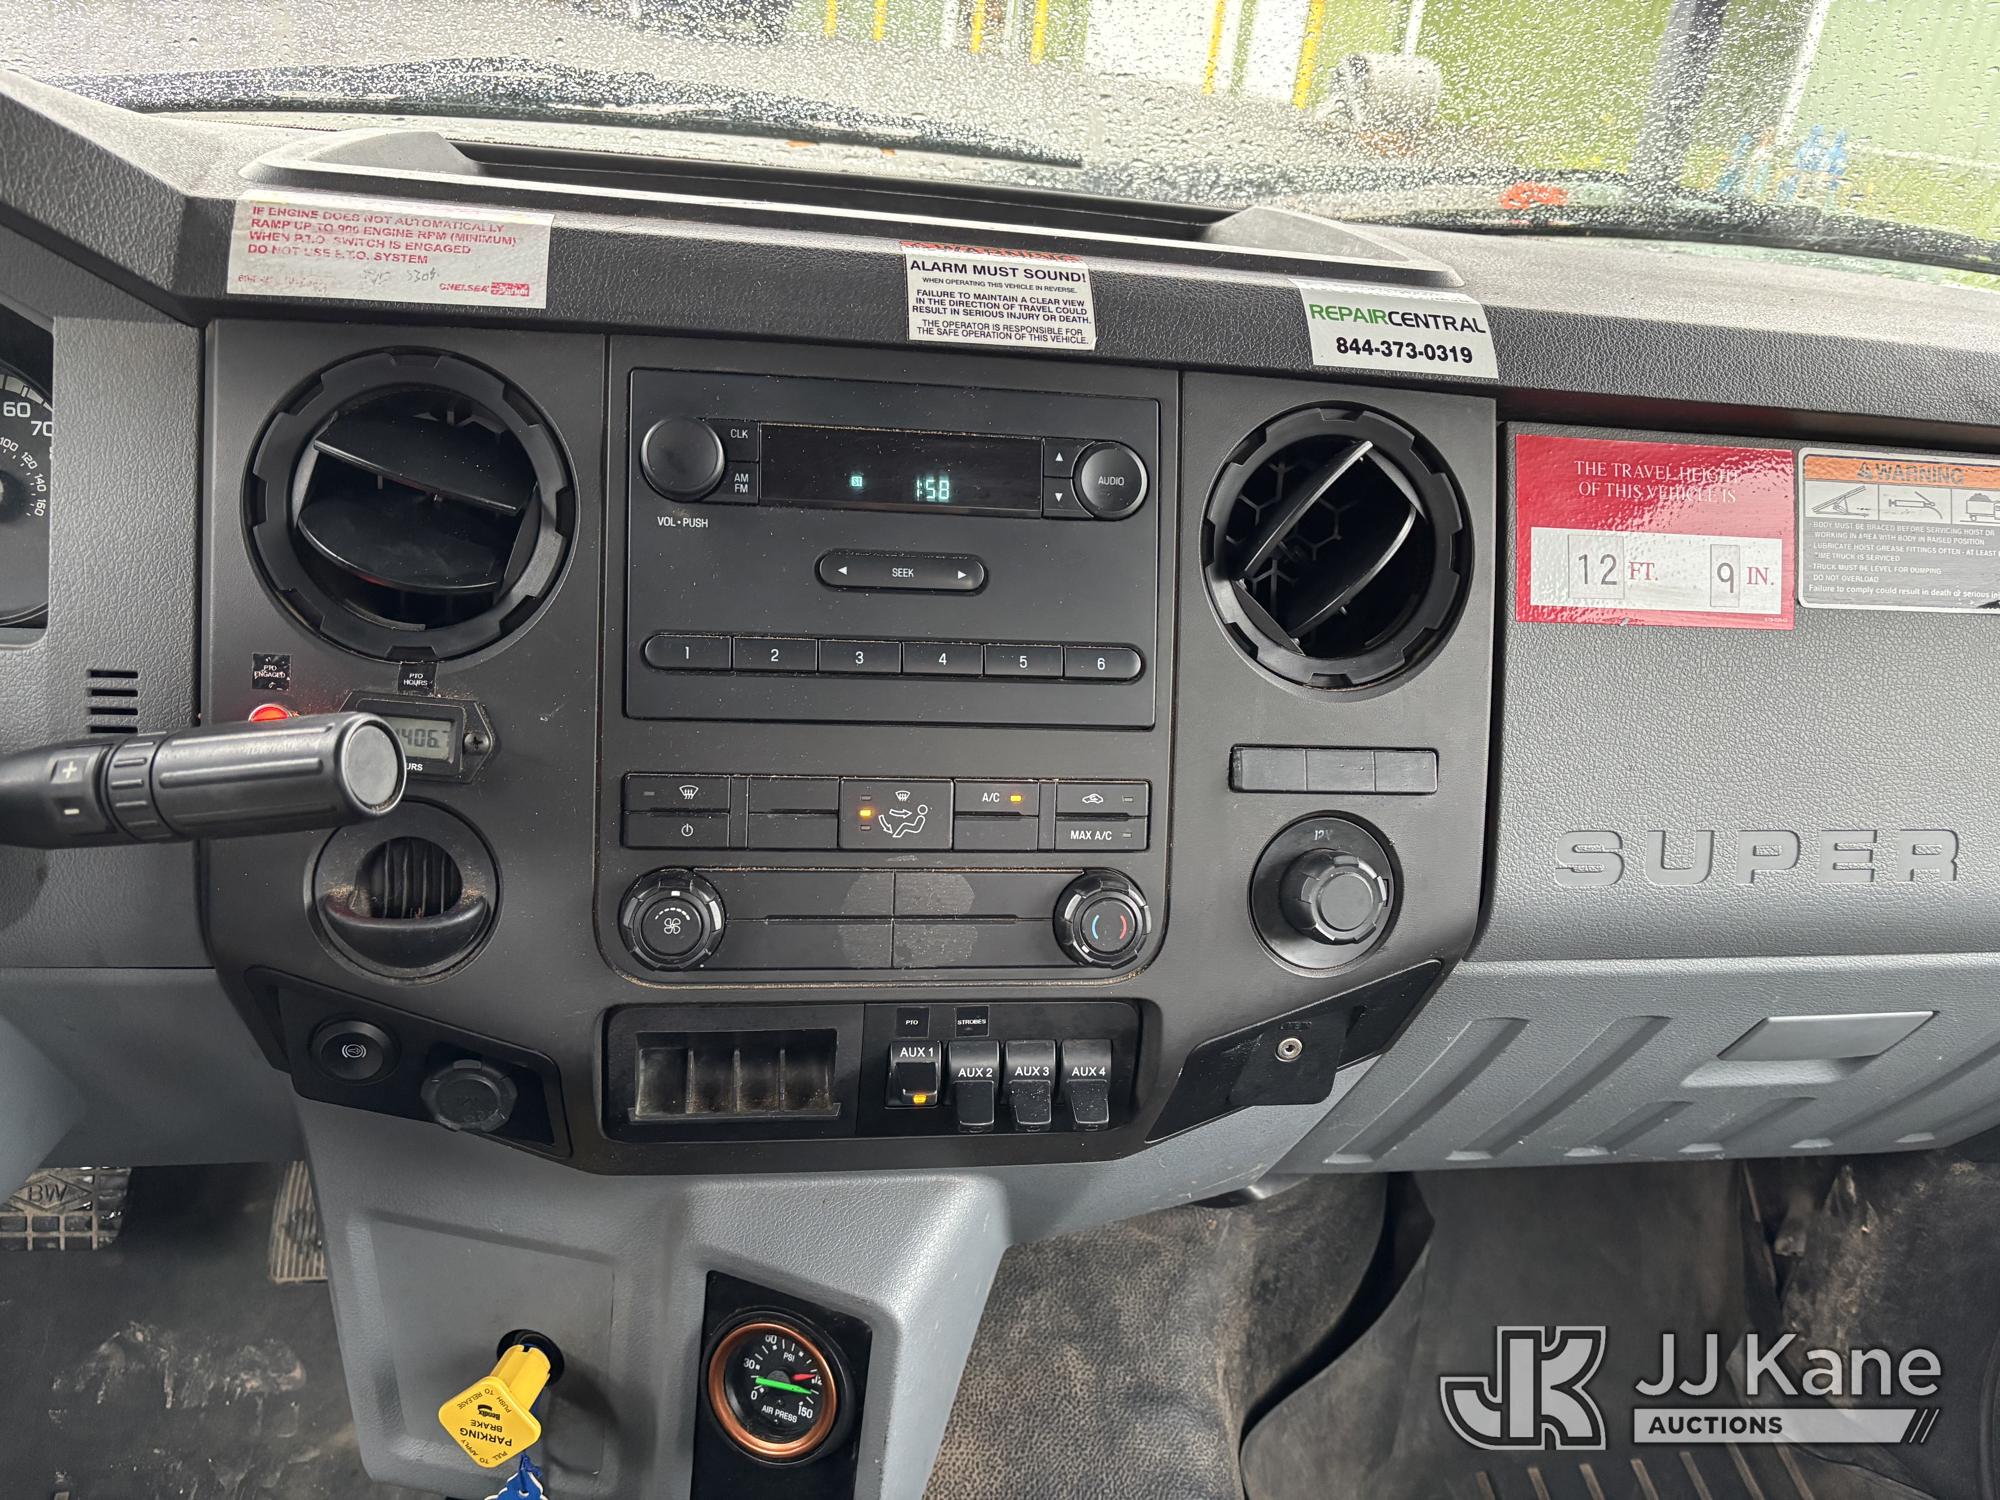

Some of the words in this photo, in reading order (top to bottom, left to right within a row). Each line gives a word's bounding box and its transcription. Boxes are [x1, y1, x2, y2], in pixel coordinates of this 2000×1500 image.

[253, 206, 264, 215] IF
[269, 207, 319, 219] ENGINE
[323, 211, 360, 222] DOES
[364, 214, 392, 224] NOT
[395, 217, 504, 232] AUTOMATICALLY
[251, 218, 290, 229] RAMP
[294, 221, 312, 230] UP
[317, 223, 333, 232] TO
[338, 225, 359, 234] 900
[363, 226, 413, 238] ENGINE
[417, 230, 446, 240] RPM
[450, 232, 516, 247] (MINIMUM)
[249, 231, 289, 241] WHEN
[334, 236, 385, 248] SWITCH
[389, 241, 400, 250] IS
[405, 242, 471, 254] ENGAGED
[248, 244, 267, 254] DO
[272, 245, 300, 255] NOT
[373, 252, 428, 264] SYSTEM
[911, 260, 968, 274] ALARM
[973, 264, 1019, 277] MUST
[1024, 268, 1086, 282] SOUND!
[946, 279, 986, 287] OPERATING
[1005, 283, 1034, 291] VEHICLE
[915, 297, 925, 305] IN
[927, 298, 947, 306] THE
[948, 299, 1000, 310] DIRECTION
[1018, 304, 1053, 313] TRAVEL
[1055, 306, 1087, 315] COULD
[916, 289, 956, 298] FAILURE
[957, 291, 970, 300] TO
[973, 293, 1018, 302] MAINTAIN
[1029, 297, 1060, 305] CLEAR
[1062, 299, 1085, 307] VIEW
[912, 305, 948, 315] RESULT
[950, 308, 960, 316] IN
[962, 308, 1004, 318] SERIOUS
[1006, 311, 1040, 321] INJURY
[1042, 313, 1057, 322] OR
[1058, 315, 1092, 324] DEATH.
[1309, 303, 1487, 334] REPAIRCENTRAL
[916, 326, 935, 335] THE
[936, 328, 960, 337] SAFE
[961, 329, 1012, 340] OPERATION
[1014, 332, 1027, 341] OF
[1028, 333, 1049, 342] THIS
[1050, 335, 1089, 345] VEHICLE.
[922, 319, 940, 328] THE
[942, 320, 990, 330] OPERATOR
[992, 323, 1000, 332] IS
[1002, 324, 1063, 335] RESPONSIBLE
[1065, 328, 1083, 336] FOR
[1336, 336, 1473, 364] 844-373-0319
[3, 402, 31, 418] 60
[30, 421, 53, 436] 70
[730, 429, 748, 439] CLK
[0, 437, 19, 451] 100
[21, 452, 38, 469] 120
[734, 473, 749, 483] AM
[1574, 460, 1607, 477] THE
[1611, 462, 1674, 481] TRAVEL
[1680, 466, 1738, 484] HEIGHT
[1876, 462, 1966, 485] WARNING
[34, 474, 47, 492] 140
[734, 484, 748, 493] FM
[916, 479, 950, 500] 1:58
[1098, 476, 1125, 486] AUDIO
[1578, 482, 1601, 496] OF
[1604, 483, 1643, 499] THIS
[1648, 485, 1717, 502] VEHICLE
[1722, 489, 1736, 503] IS
[34, 499, 46, 517] 160
[1866, 523, 1895, 531] BRACED
[1897, 525, 1925, 533] BEFORE
[1926, 527, 1961, 535] SERVICING
[1964, 528, 1983, 536] HOIST
[1814, 531, 1848, 539] WORKING
[1927, 536, 1952, 544] RAISED
[1953, 537, 1985, 546] POSITION
[1813, 542, 1852, 550] LUBRICATE
[1853, 543, 1875, 551] HOIST
[1876, 545, 1904, 553] GREASE
[1906, 546, 1937, 554] FITTINGS
[1938, 547, 1961, 555] OFTEN
[1976, 549, 1997, 557] LEAST
[892, 568, 914, 578] SEEK
[1578, 553, 1618, 585] 12
[1629, 562, 1659, 581] FT.
[1716, 562, 1735, 594] 9
[1747, 566, 1775, 585] IN.
[1871, 565, 1892, 573] LEVEL
[1910, 567, 1942, 575] DUMPING
[1841, 575, 1879, 583] OVERLOAD
[1808, 584, 1835, 592] Failure
[1846, 586, 1873, 595] comply
[1931, 589, 1952, 597] death
[684, 647, 690, 659] 1
[770, 649, 779, 661] 2
[855, 652, 863, 664] 3
[938, 653, 947, 665] 4
[1019, 656, 1027, 668] 5
[1097, 658, 1105, 670] 6
[982, 791, 1000, 803] A/C
[1070, 830, 1092, 841] MAX
[1094, 830, 1113, 841] A/C
[1555, 829, 1959, 886] SUPER
[900, 1047, 925, 1058] AUX
[928, 1047, 934, 1057] 1
[958, 1068, 983, 1078] AUX
[986, 1068, 993, 1078] 2
[1015, 1067, 1040, 1077] AUX
[1042, 1067, 1050, 1077] 3
[1072, 1067, 1097, 1077] AUX
[1098, 1067, 1106, 1077] 4
[29, 1184, 68, 1201] BW
[743, 1358, 755, 1369] 30
[783, 1352, 795, 1362] PSI
[457, 1392, 483, 1409] RELEASE
[761, 1405, 774, 1415] AIR
[774, 1410, 798, 1423] PRESS
[798, 1404, 814, 1419] 150
[470, 1419, 503, 1433] BRAKE
[459, 1427, 513, 1447] PARKING
